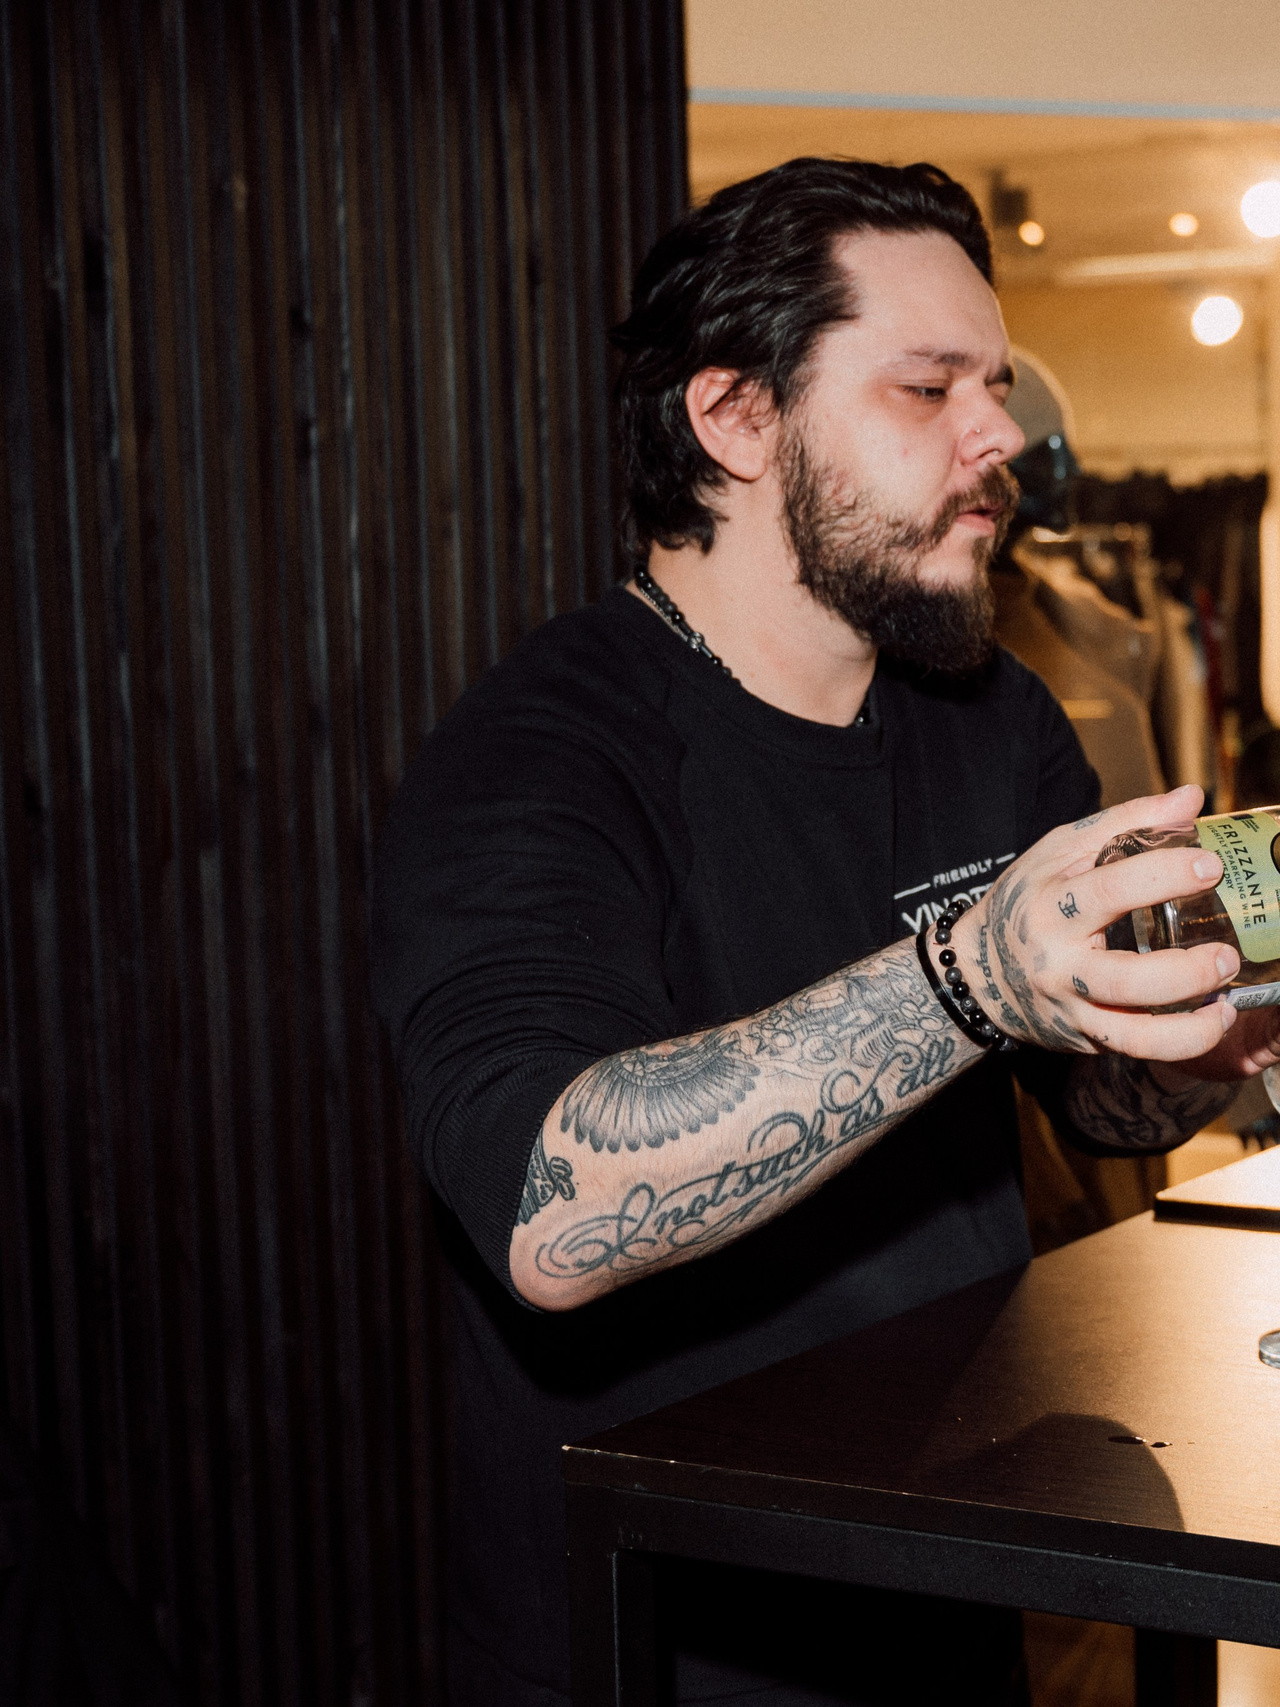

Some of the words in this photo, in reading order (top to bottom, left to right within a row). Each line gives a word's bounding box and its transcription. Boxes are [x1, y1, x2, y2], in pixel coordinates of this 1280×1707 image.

[932, 858, 994, 888] FRIENDLY
[1206, 824, 1228, 848] LIGHTLY
[1224, 850, 1247, 900] SPARKLING
[1241, 903, 1251, 929] WINE
[1218, 823, 1267, 925] FRIZZANTE
[1224, 873, 1234, 890] DRY
